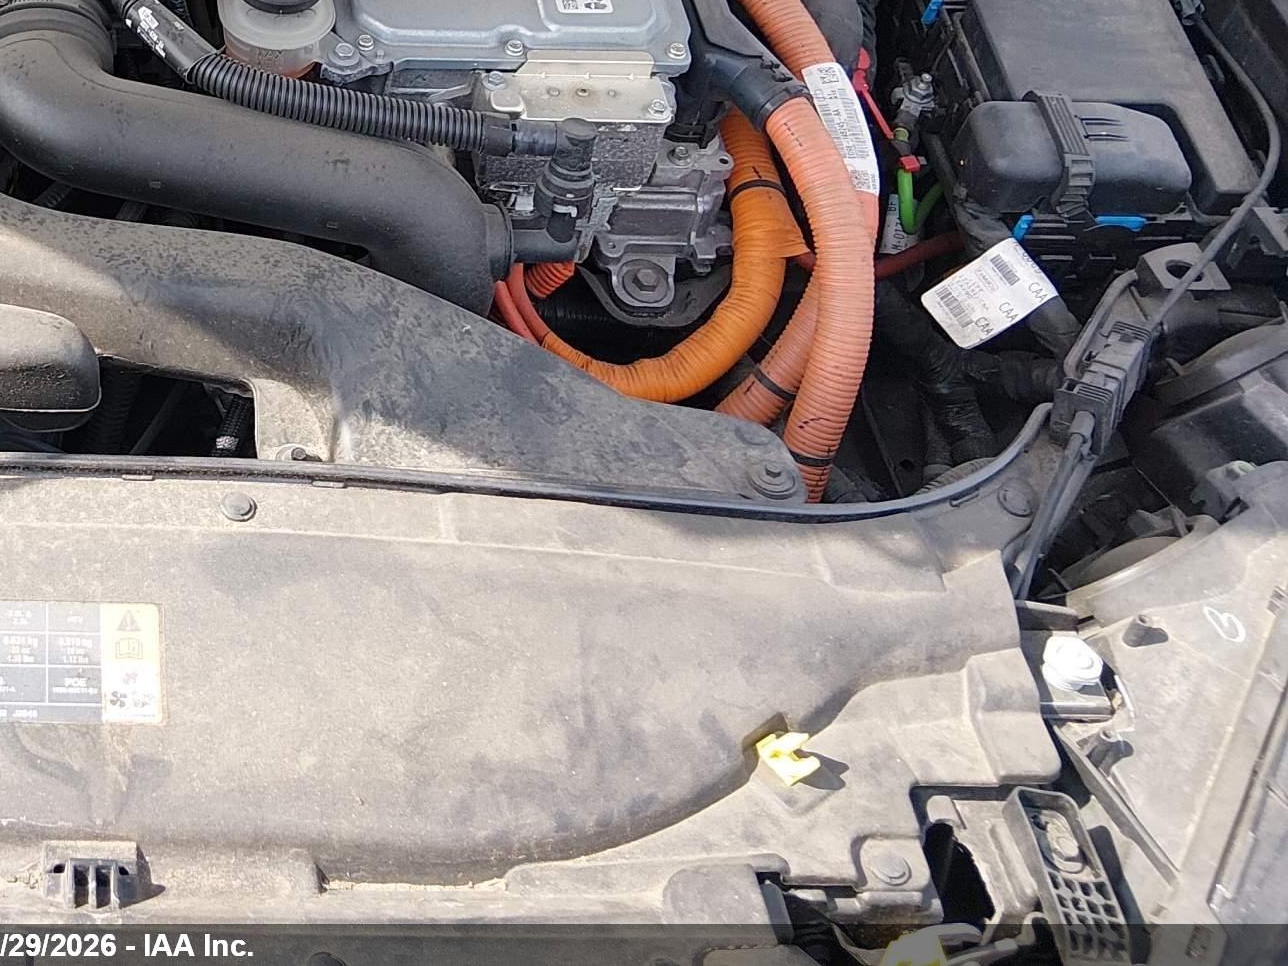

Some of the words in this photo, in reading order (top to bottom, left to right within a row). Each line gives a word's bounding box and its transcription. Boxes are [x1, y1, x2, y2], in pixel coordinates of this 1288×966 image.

[1028, 282, 1050, 302] CAA
[998, 301, 1020, 322] CAA
[975, 316, 995, 336] CAA
